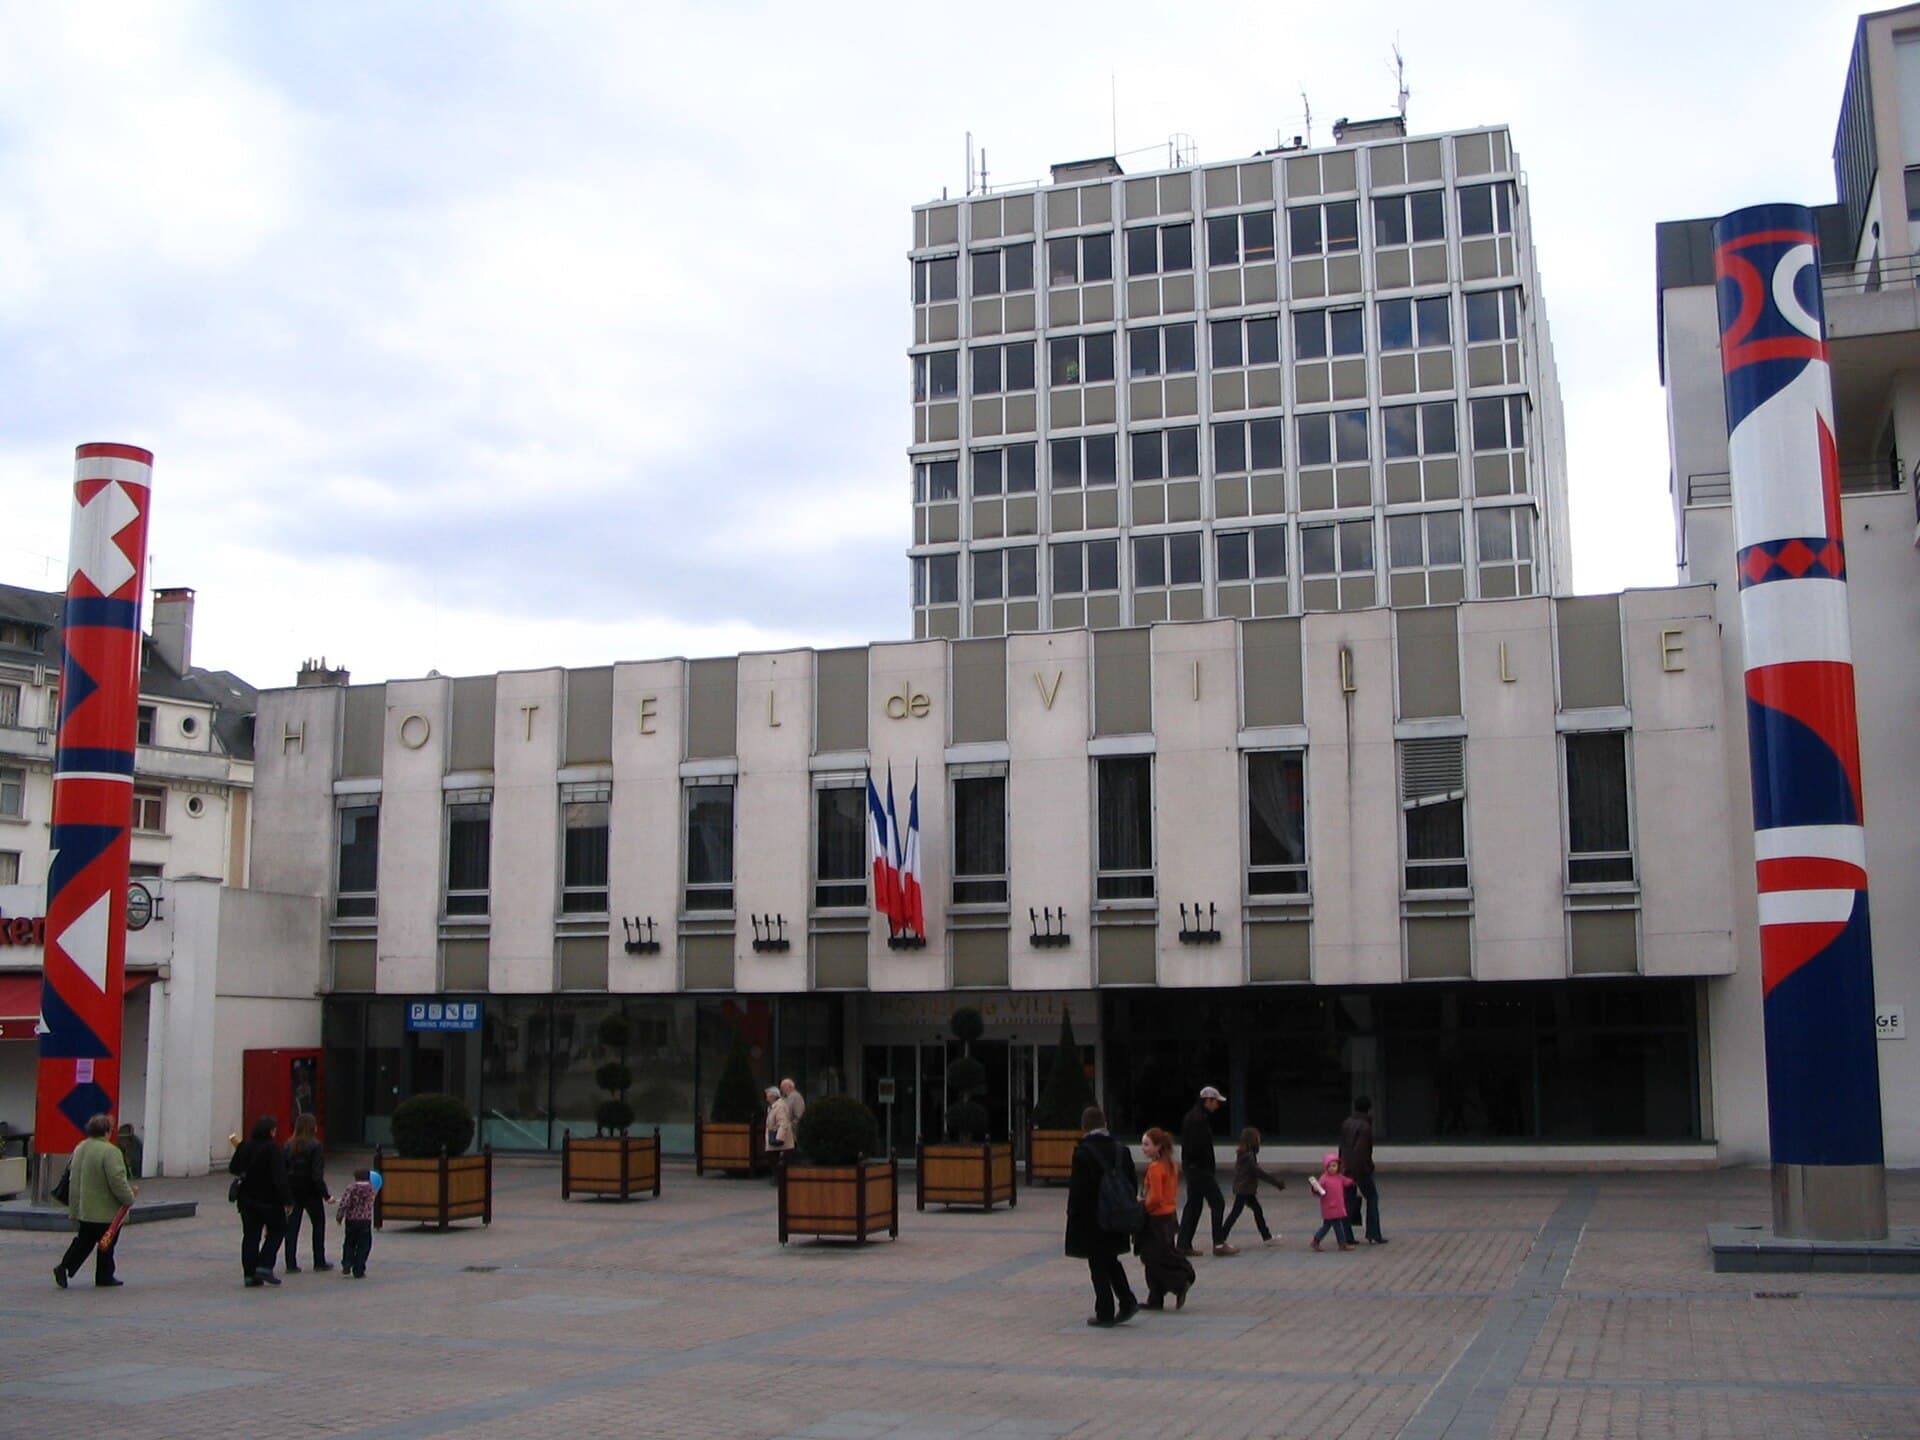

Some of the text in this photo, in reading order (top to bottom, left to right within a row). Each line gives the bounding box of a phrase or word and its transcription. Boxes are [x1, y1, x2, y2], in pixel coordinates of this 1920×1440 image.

[282, 629, 1685, 754] HOTEL de VILLE
